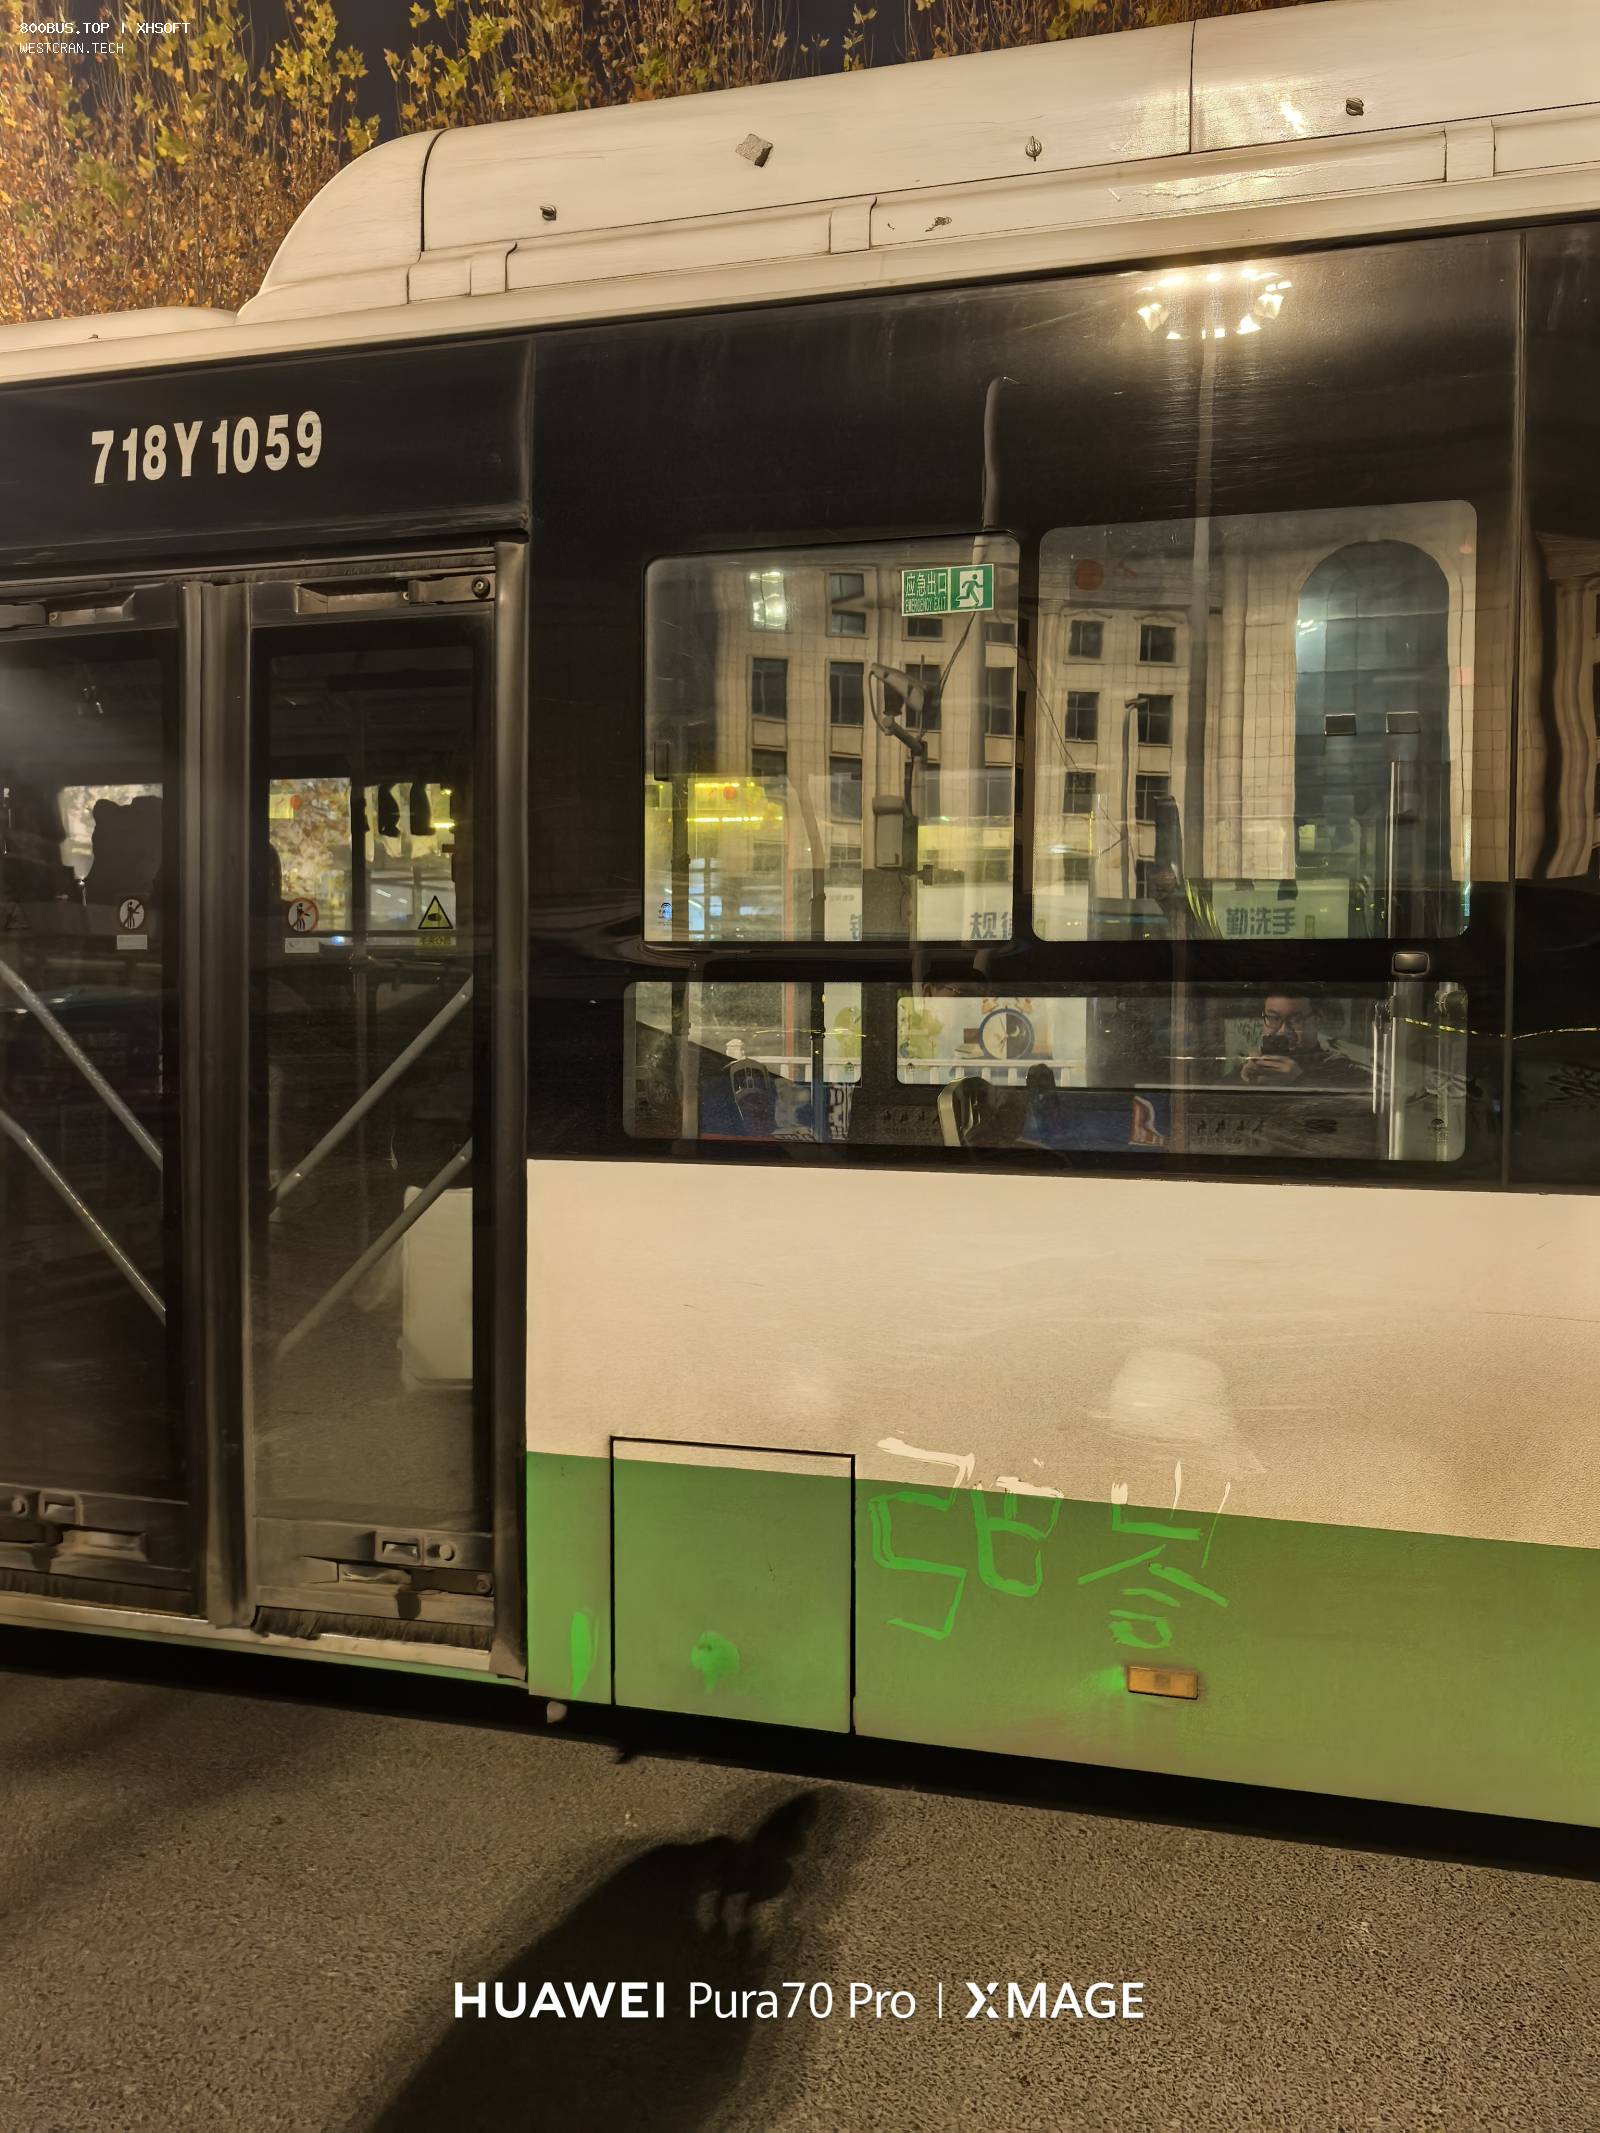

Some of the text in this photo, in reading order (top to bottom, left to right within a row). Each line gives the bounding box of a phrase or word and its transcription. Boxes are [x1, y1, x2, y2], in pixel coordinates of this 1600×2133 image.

[91, 410, 322, 484] 718Y1059
[905, 570, 947, 597] 应急出口
[1226, 907, 1296, 936] 勤洗手
